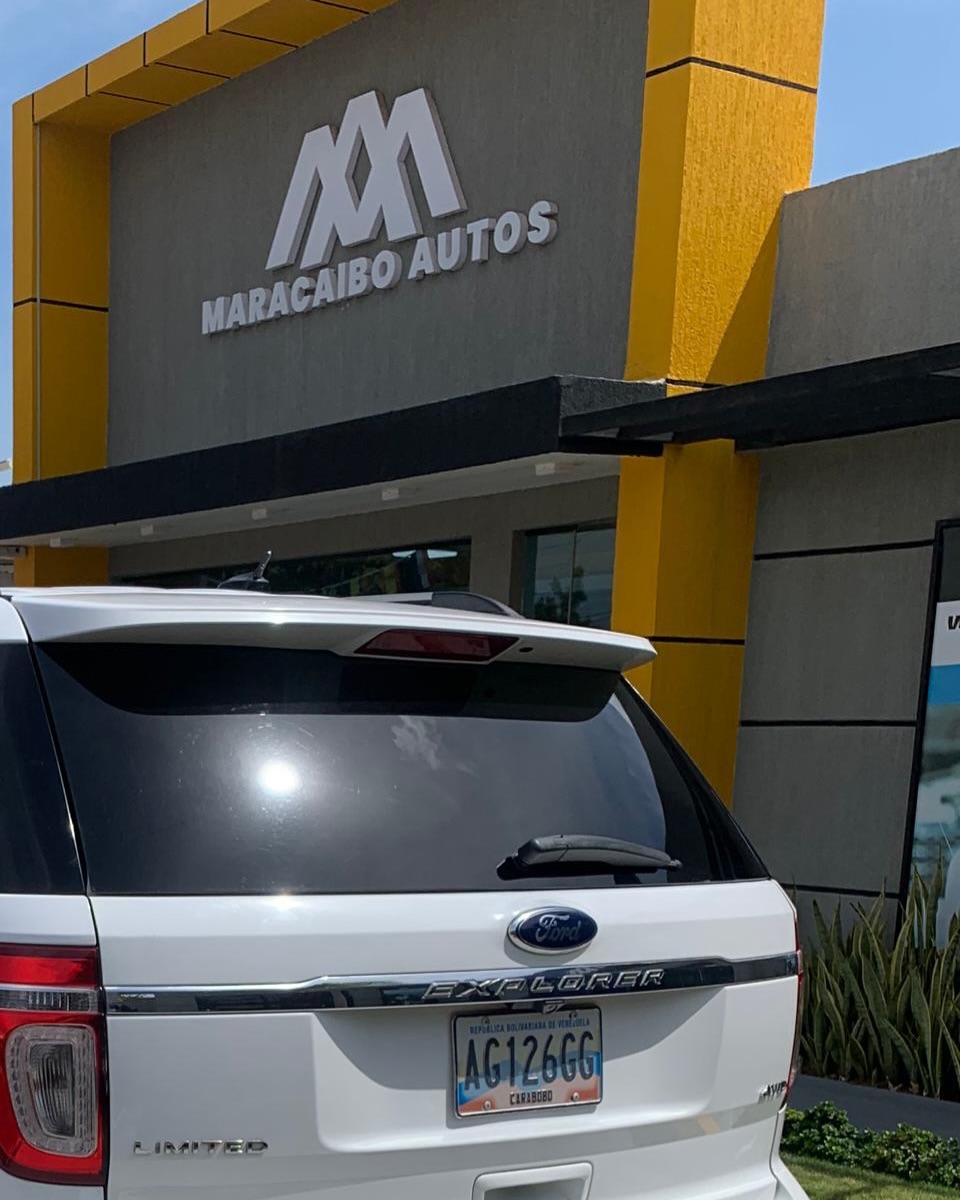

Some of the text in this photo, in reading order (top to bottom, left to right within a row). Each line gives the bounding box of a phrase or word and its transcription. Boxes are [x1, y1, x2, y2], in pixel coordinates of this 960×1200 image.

[202, 200, 559, 336] MARACAIBO AUTOS
[535, 913, 582, 943] Ford
[422, 968, 665, 1001] EXPLORER
[464, 1030, 595, 1091] AG126GG
[510, 1089, 553, 1106] CARABOBO
[133, 1138, 269, 1157] LIMITED
